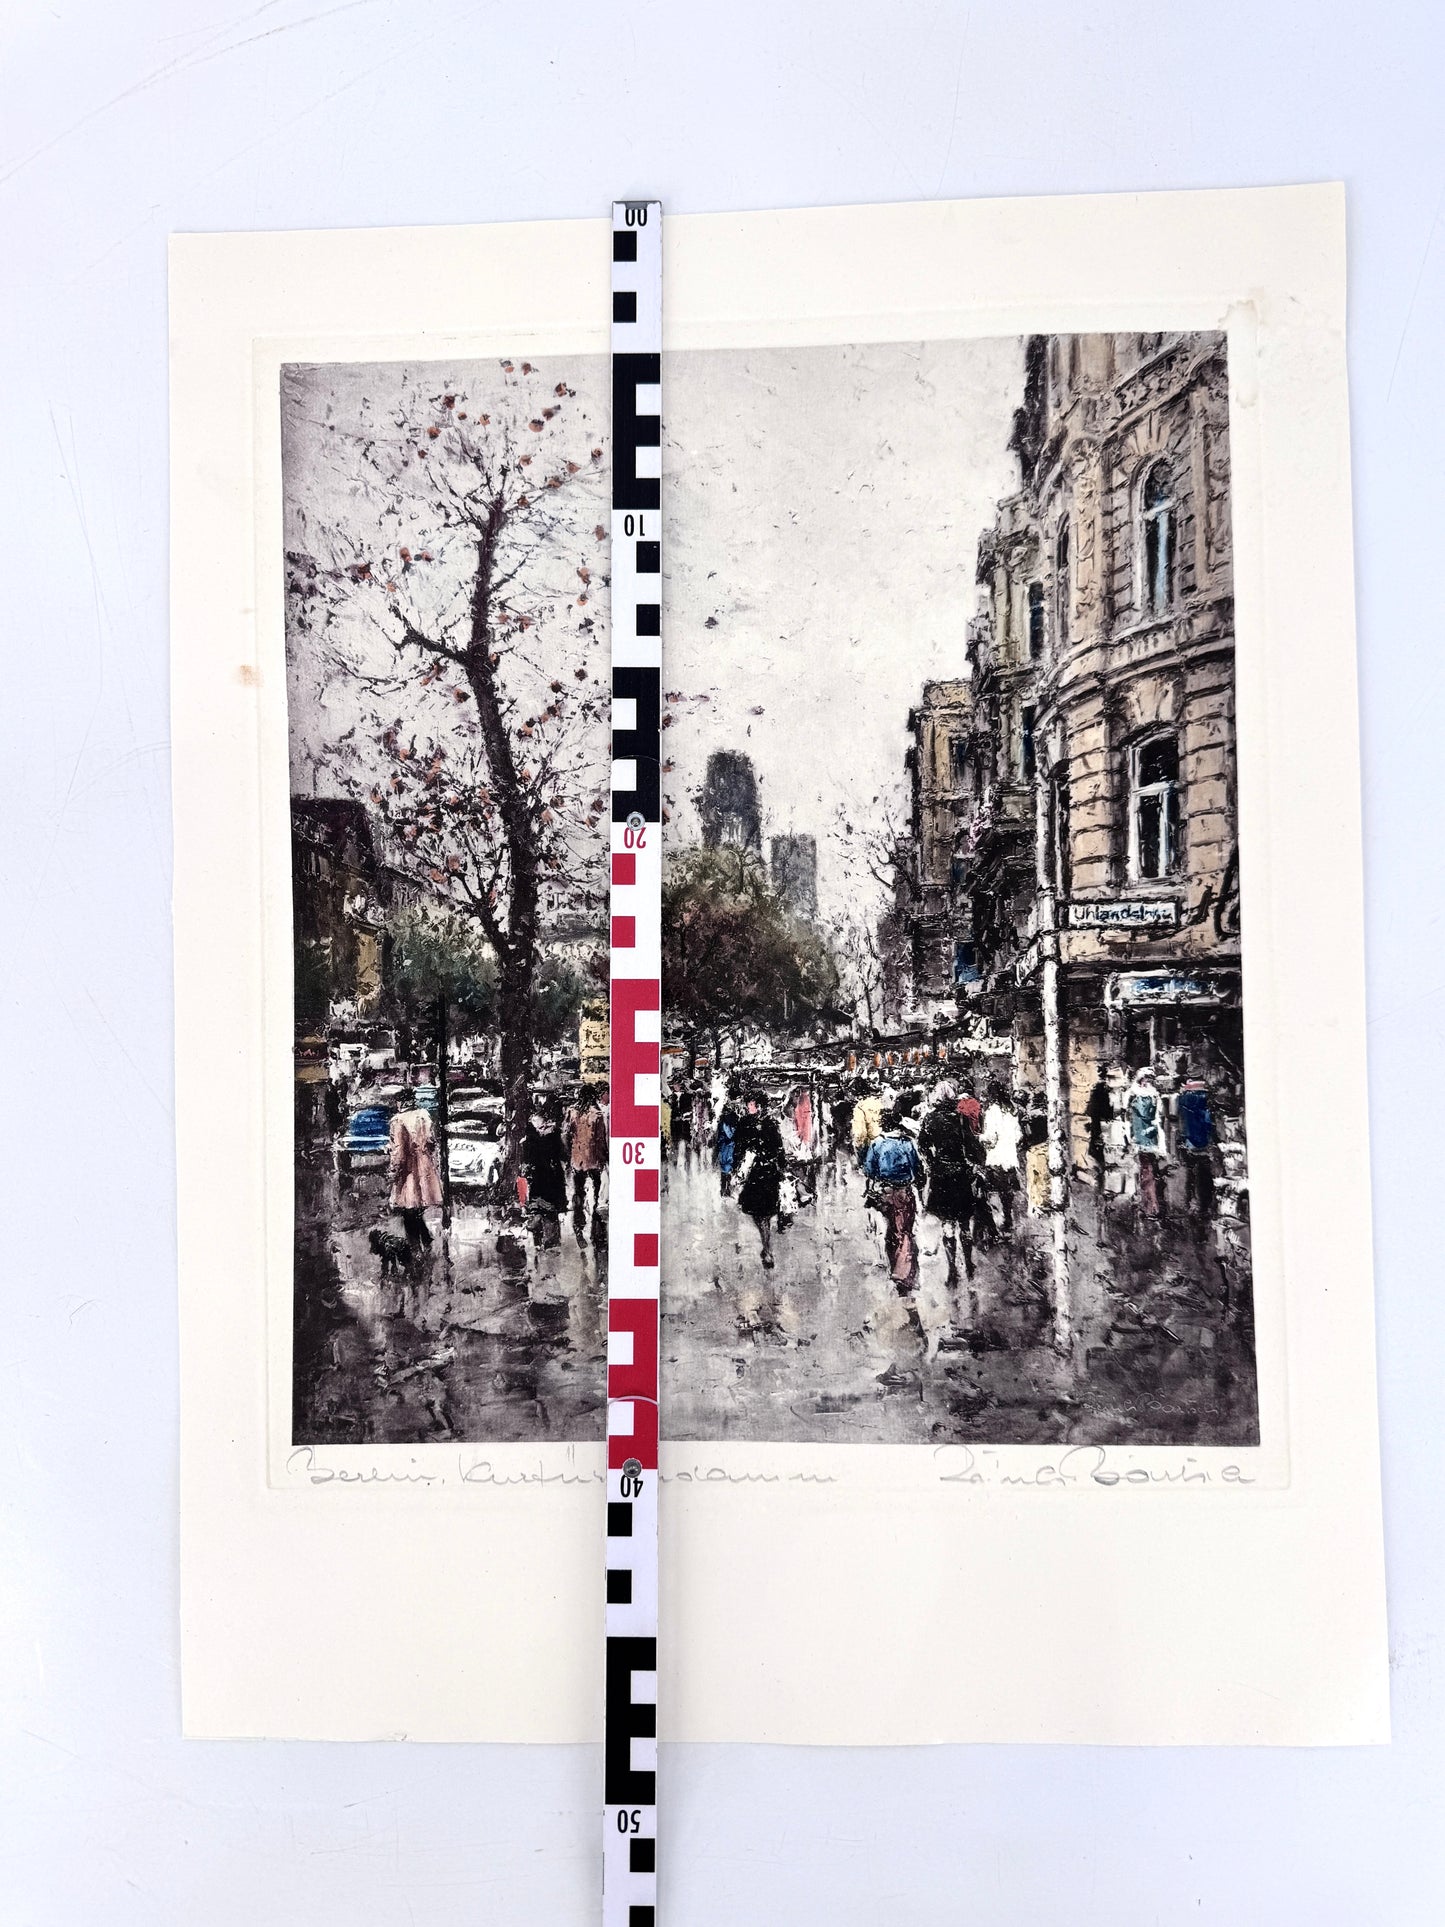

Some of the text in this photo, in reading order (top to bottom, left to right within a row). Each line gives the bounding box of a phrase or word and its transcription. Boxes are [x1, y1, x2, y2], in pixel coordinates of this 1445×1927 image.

[624, 208, 648, 227] 00
[624, 514, 646, 537] 10
[623, 826, 647, 849] 20
[622, 1142, 646, 1165] 30
[620, 1474, 644, 1498] 40
[617, 1809, 641, 1834] 50
